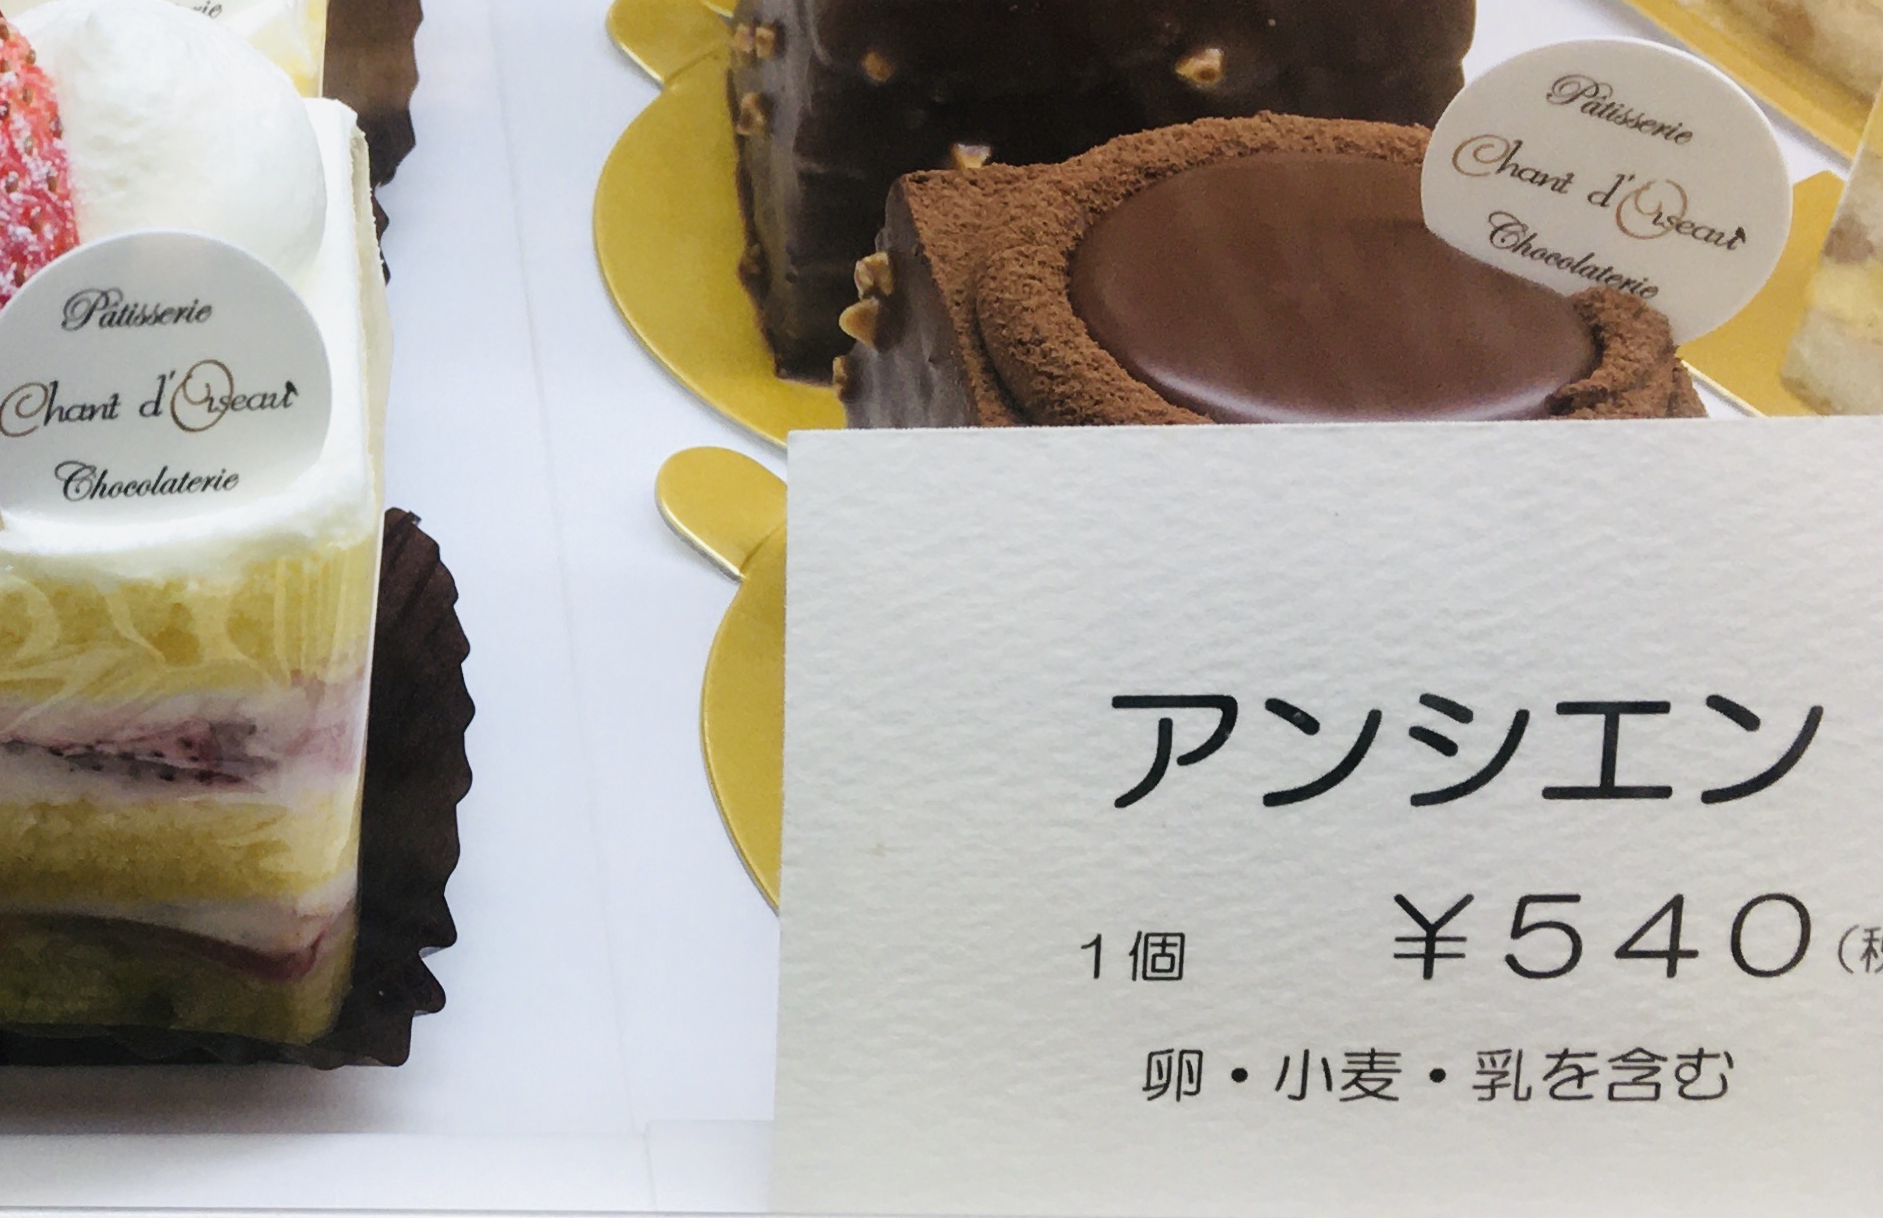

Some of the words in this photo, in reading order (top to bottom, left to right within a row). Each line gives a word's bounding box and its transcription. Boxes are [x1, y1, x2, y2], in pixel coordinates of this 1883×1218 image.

[1547, 74, 1693, 145] Pâtisserie
[1452, 134, 1574, 194] Chant
[1488, 211, 1659, 300] Chocolaterie
[61, 287, 212, 331] Pâtisserie
[54, 460, 239, 502] Chocolaterie
[1111, 692, 1824, 809] アンシエン
[1081, 930, 1186, 982] 1個
[1393, 892, 1812, 981] ¥540
